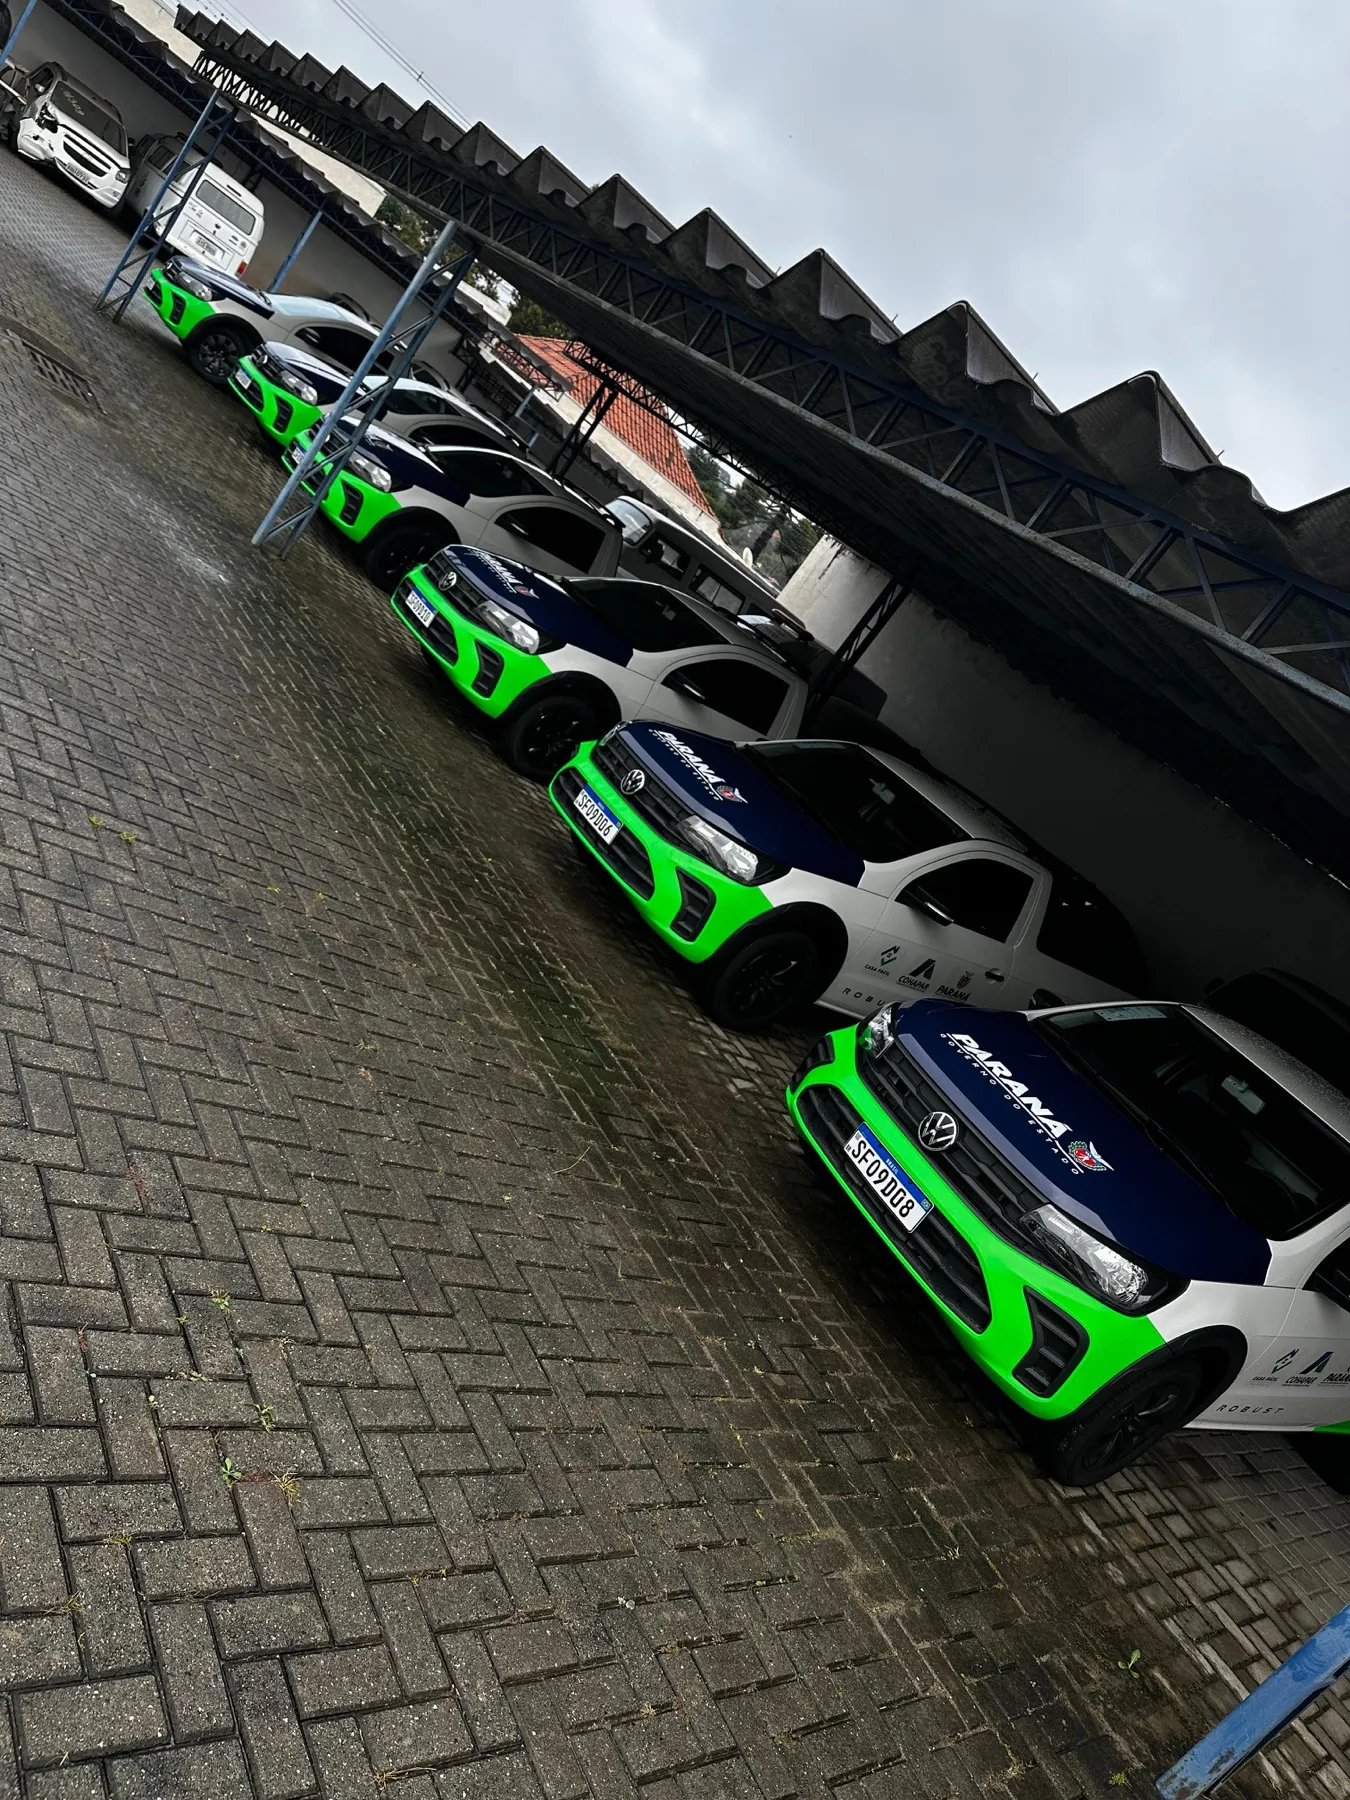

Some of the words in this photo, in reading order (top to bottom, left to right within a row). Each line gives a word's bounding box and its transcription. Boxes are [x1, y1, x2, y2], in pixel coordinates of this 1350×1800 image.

[898, 975, 931, 991] COHAPAR
[842, 987, 886, 1007] ROBU
[936, 984, 972, 1002] PARANÁ
[950, 1033, 1074, 1139] PARANÁ
[939, 1032, 998, 1086] GOVERNO
[1003, 1094, 1022, 1111] DO
[1027, 1119, 1080, 1175] ESTADO
[884, 1158, 901, 1176] BRASIL
[1215, 1404, 1285, 1414] ROBUST
